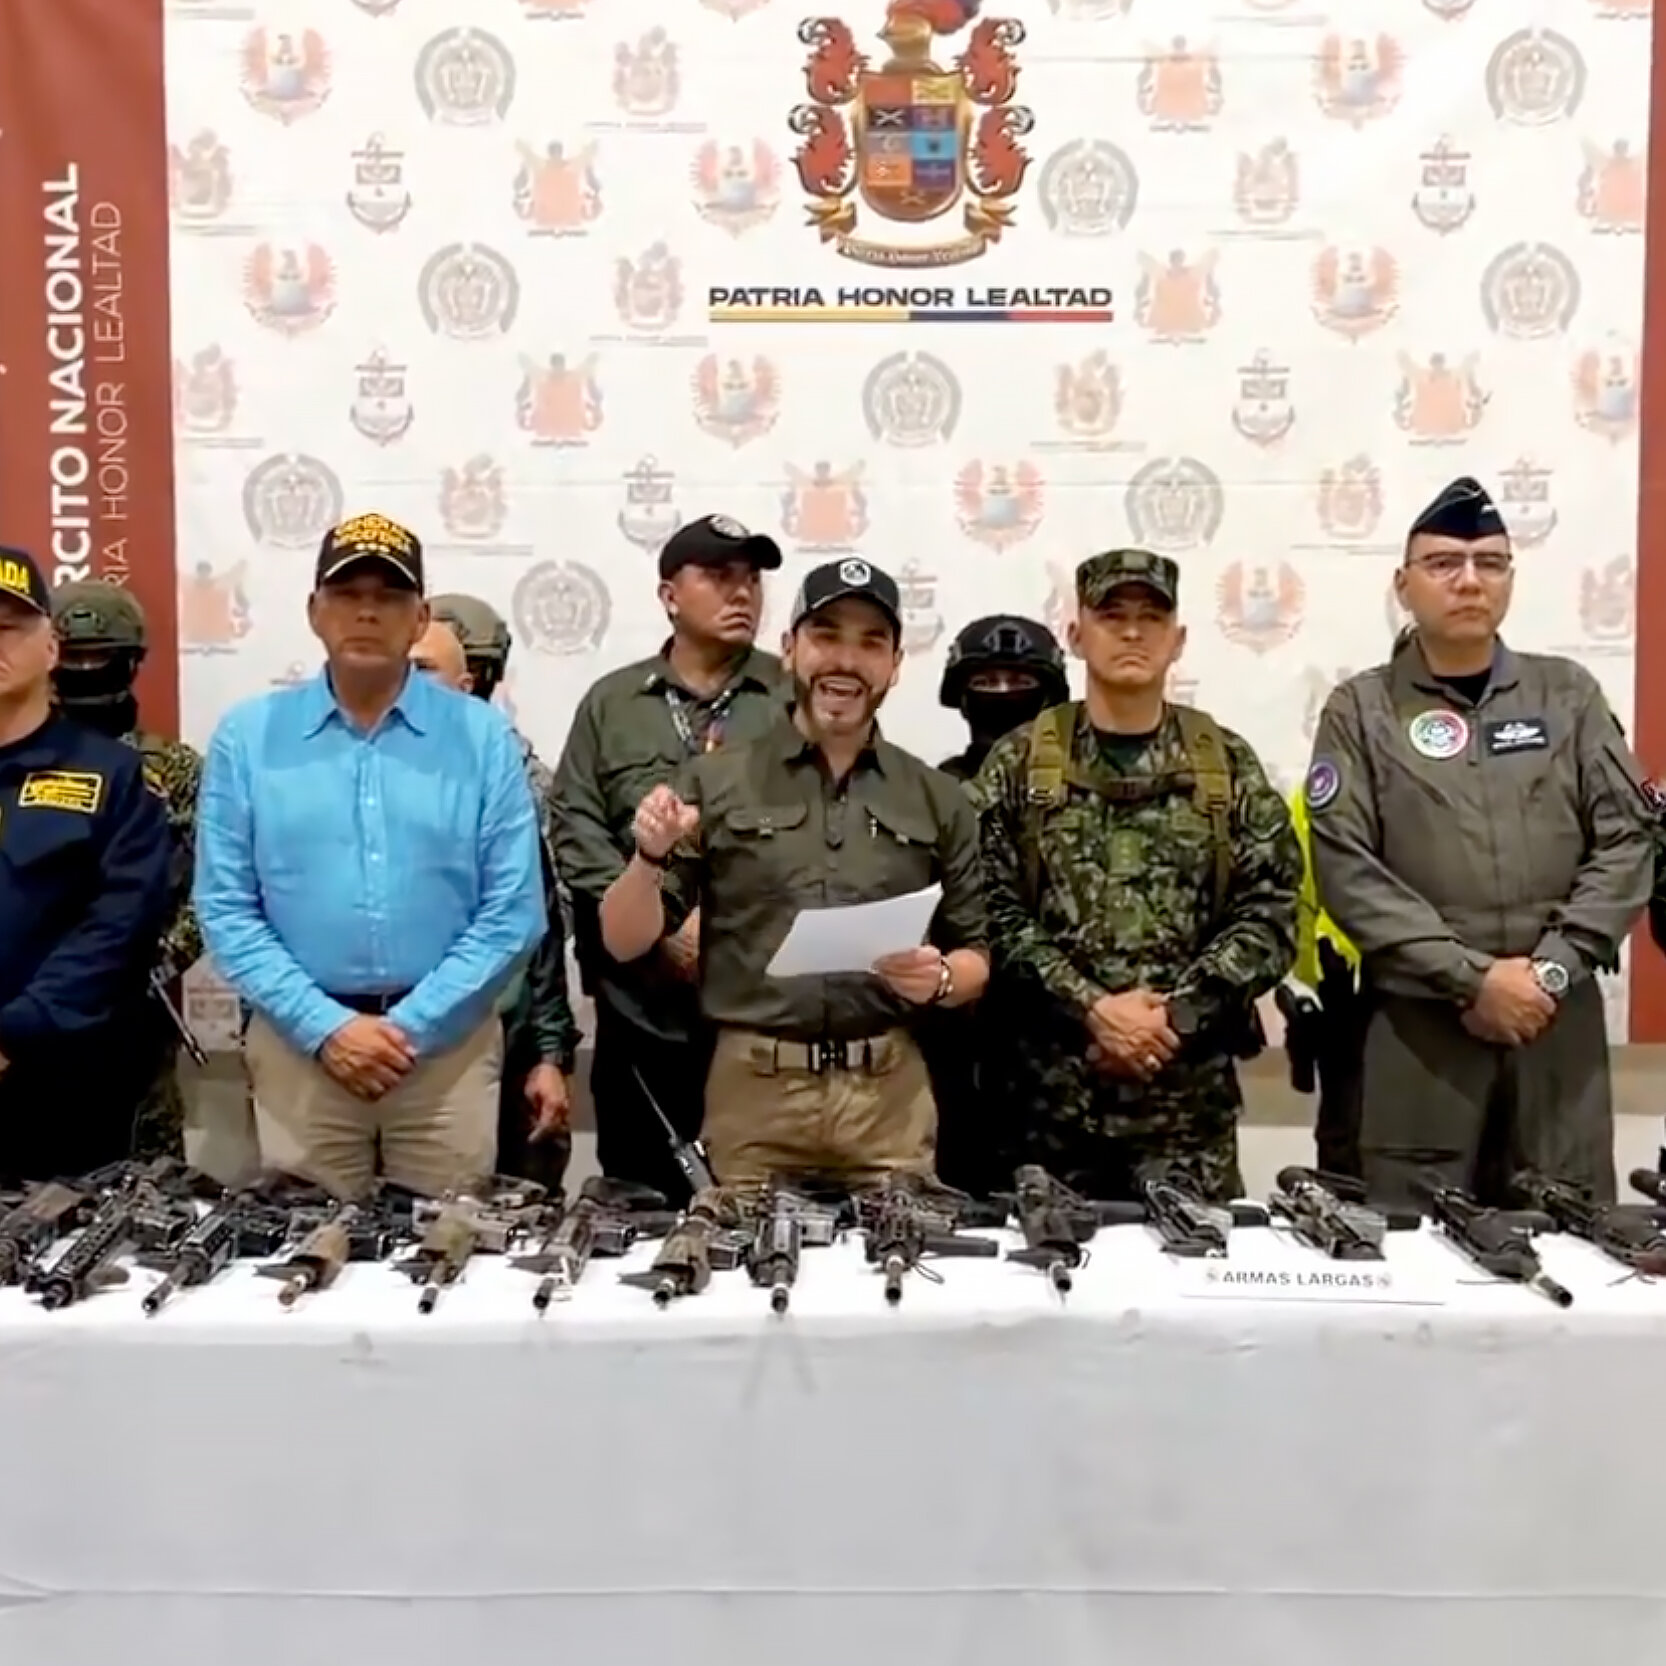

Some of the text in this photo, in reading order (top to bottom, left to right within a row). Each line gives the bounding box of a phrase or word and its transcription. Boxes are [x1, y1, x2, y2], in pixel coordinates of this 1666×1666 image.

[42, 162, 87, 434] NACIONAL
[91, 201, 125, 361] LEALTAD
[709, 287, 1112, 306] PATRIA HONOR LEALTAD
[97, 382, 128, 519] HONOR
[1223, 1270, 1373, 1287] ARMAS LARGAS
